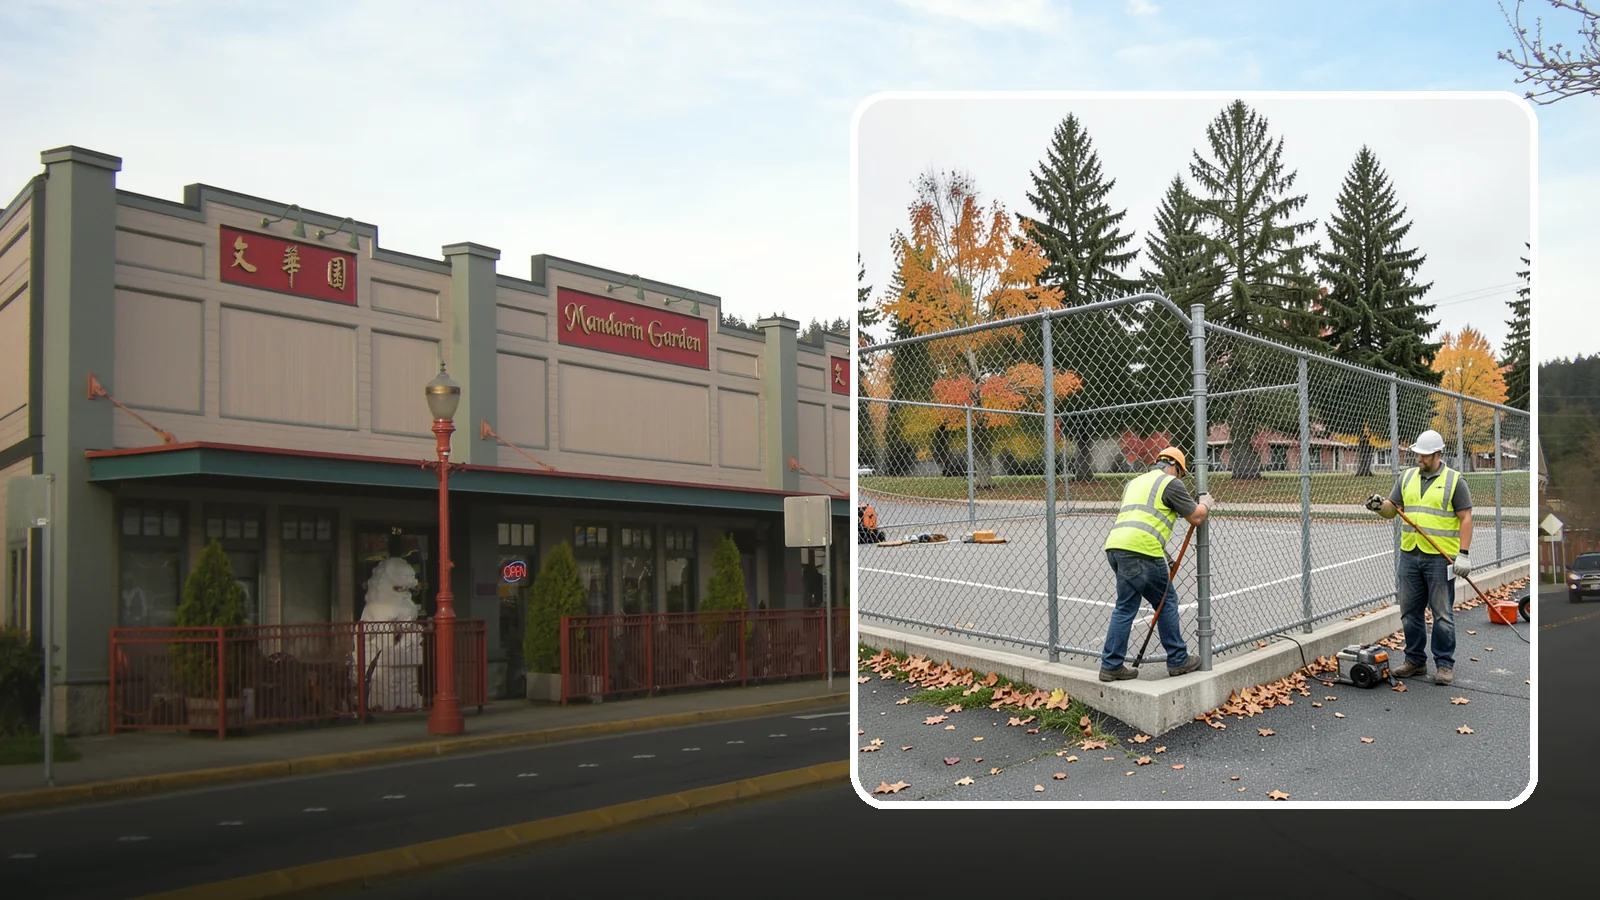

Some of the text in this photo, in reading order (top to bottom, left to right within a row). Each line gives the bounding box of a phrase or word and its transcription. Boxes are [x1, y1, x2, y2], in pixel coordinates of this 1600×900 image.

[231, 235, 346, 290] 文華園
[564, 302, 701, 352] Mandarin Garden
[834, 363, 846, 386] 文
[503, 565, 527, 578] OPEN
